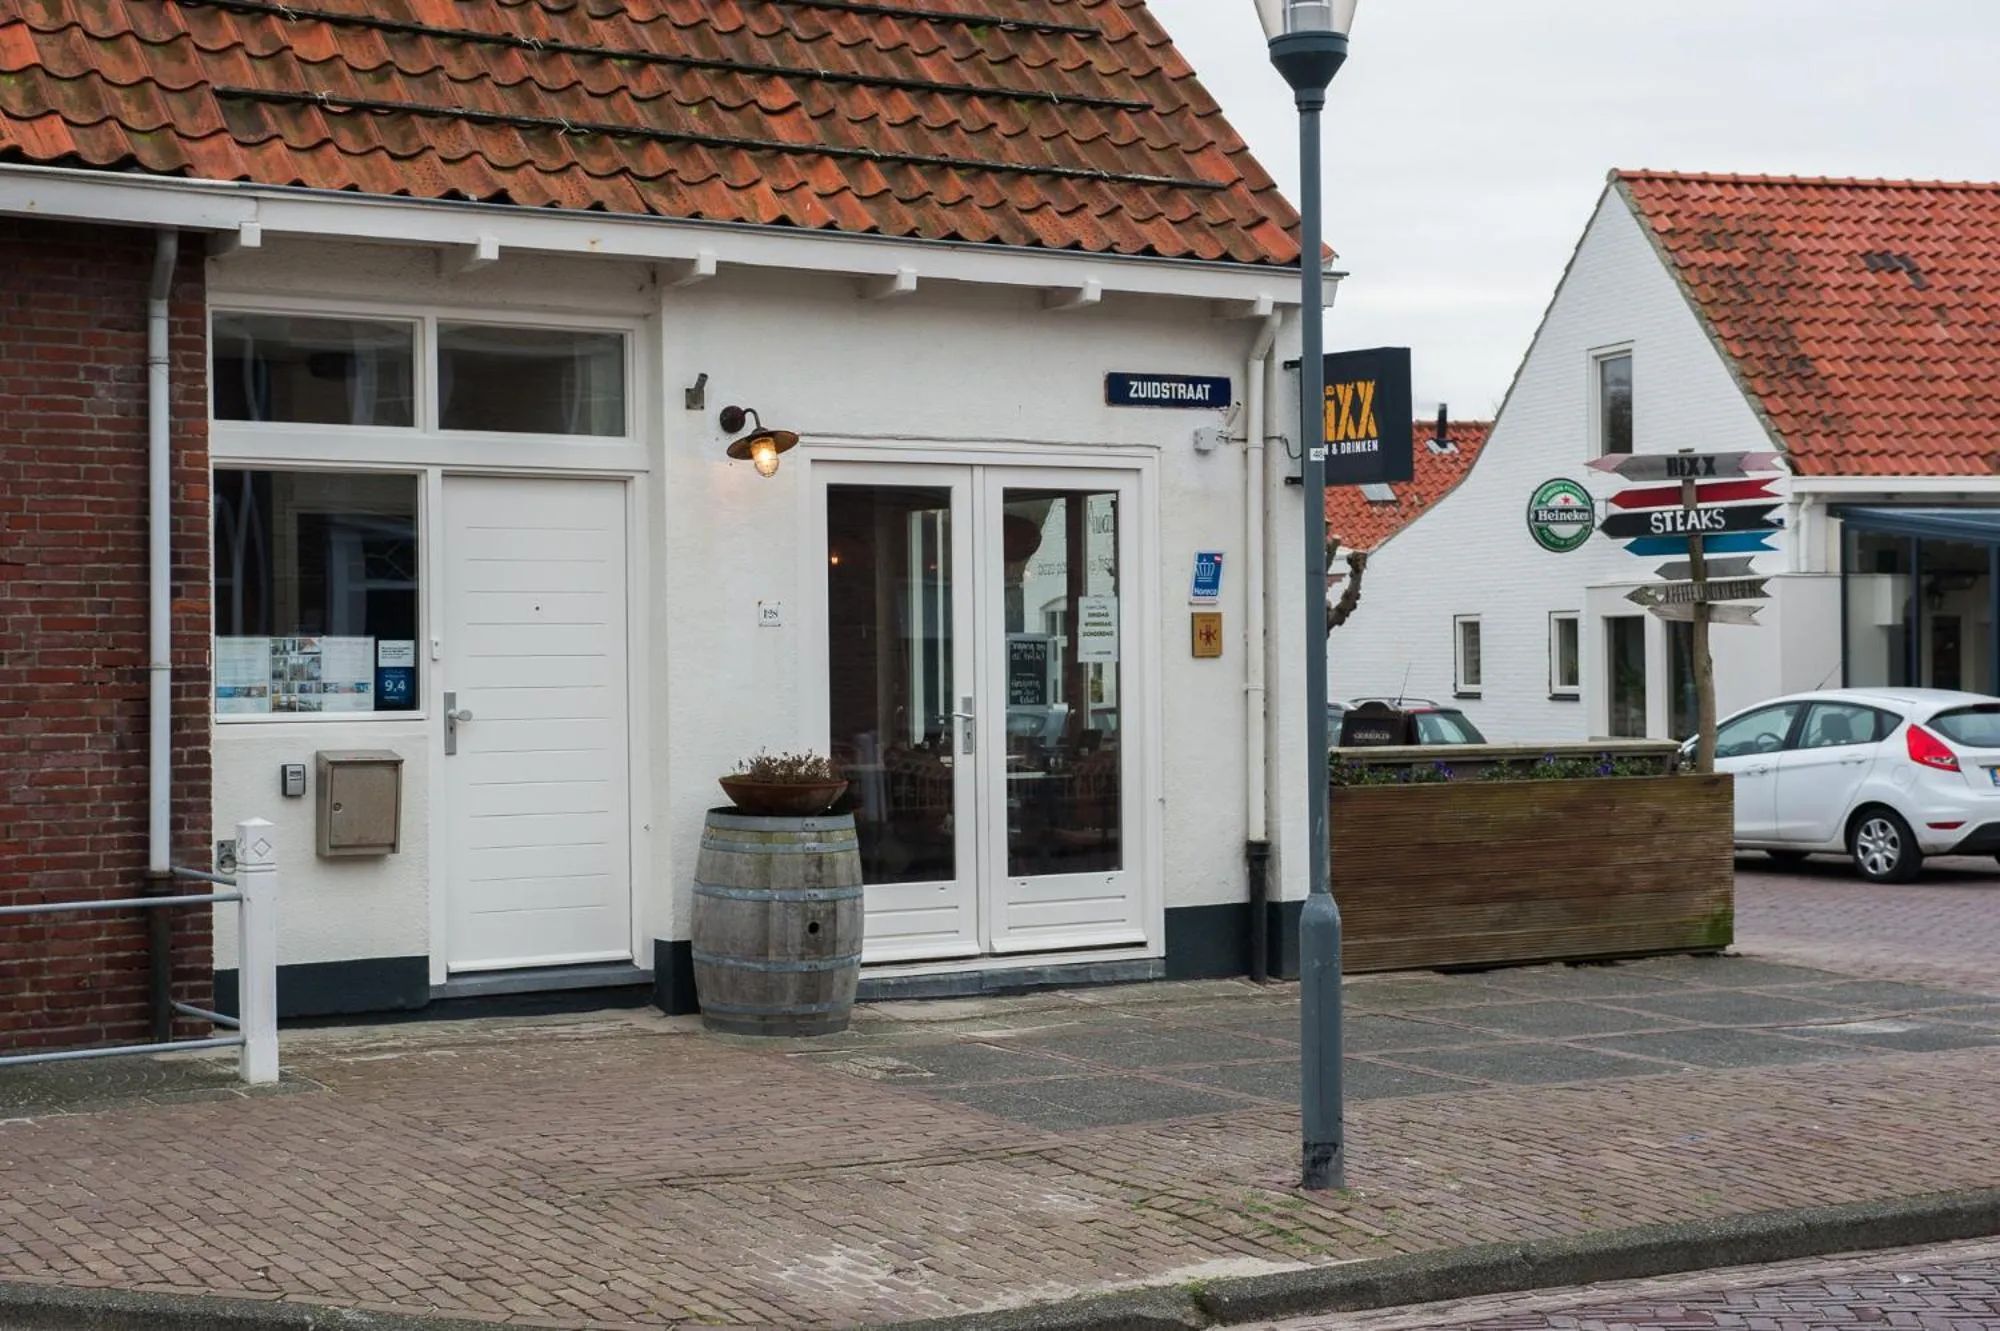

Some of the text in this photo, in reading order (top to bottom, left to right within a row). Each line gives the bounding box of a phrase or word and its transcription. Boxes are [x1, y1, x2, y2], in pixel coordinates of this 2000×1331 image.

[1129, 381, 1211, 401] ZUIDSTRAAT
[1323, 380, 1378, 442] iXX
[1341, 440, 1379, 454] DRINKEN
[1537, 508, 1590, 522] Heineken
[1650, 508, 1726, 534] STEAKS
[384, 679, 406, 692] 9.4
